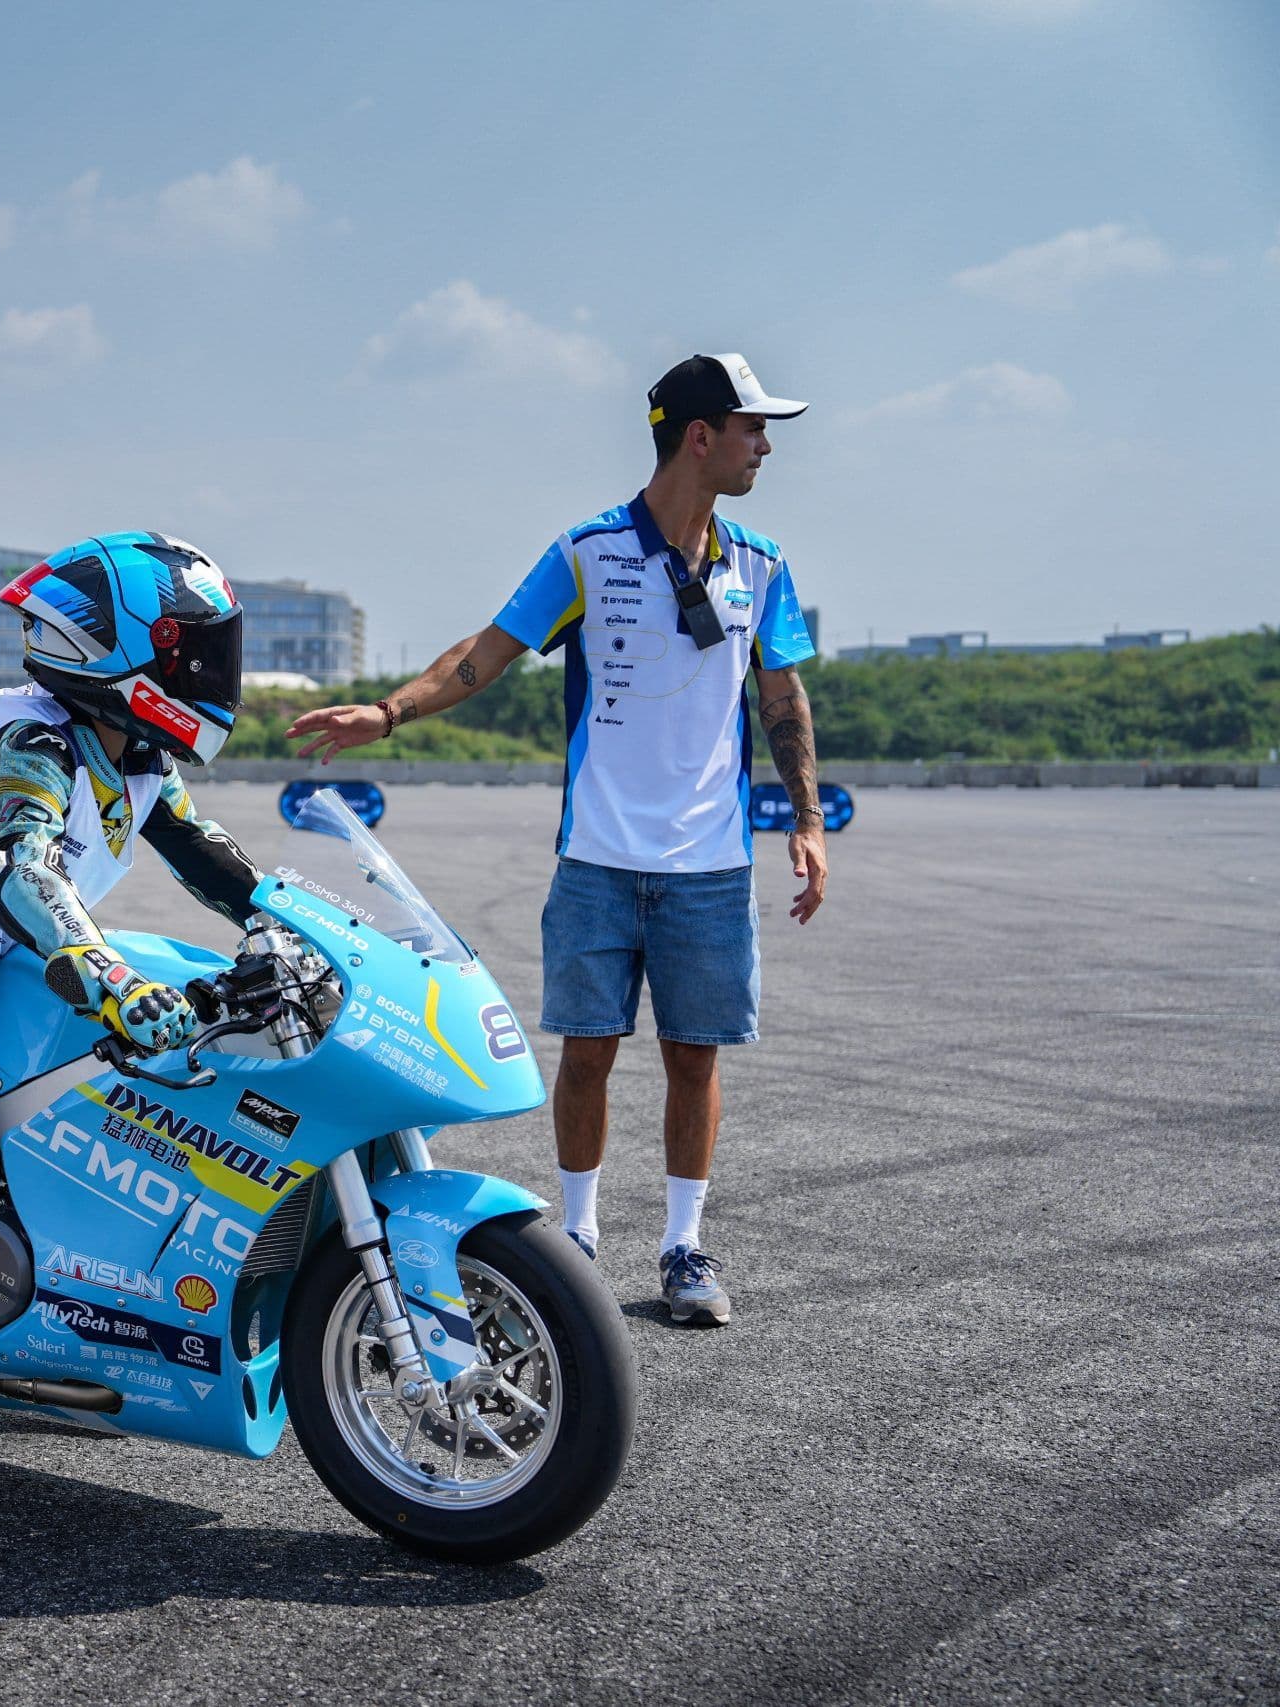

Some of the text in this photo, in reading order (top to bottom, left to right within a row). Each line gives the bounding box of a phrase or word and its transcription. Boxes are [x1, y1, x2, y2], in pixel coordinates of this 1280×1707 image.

[134, 689, 198, 732] LS2
[304, 880, 341, 903] OSMO
[341, 900, 365, 917] 360
[48, 902, 91, 943] KNIGHT
[293, 904, 369, 950] CFMOTO
[375, 995, 421, 1027] BOSCH
[368, 1013, 439, 1062] BYBRE
[480, 1003, 526, 1062] 8
[99, 1110, 193, 1174] 猛狮电池
[103, 1082, 302, 1194] DYNAVOLT
[236, 1114, 284, 1145] CFMOTO
[37, 1244, 168, 1304] ARISUN
[26, 1334, 66, 1356] Saleri
[113, 1320, 150, 1340] 智源
[177, 1353, 210, 1367] DEGANG
